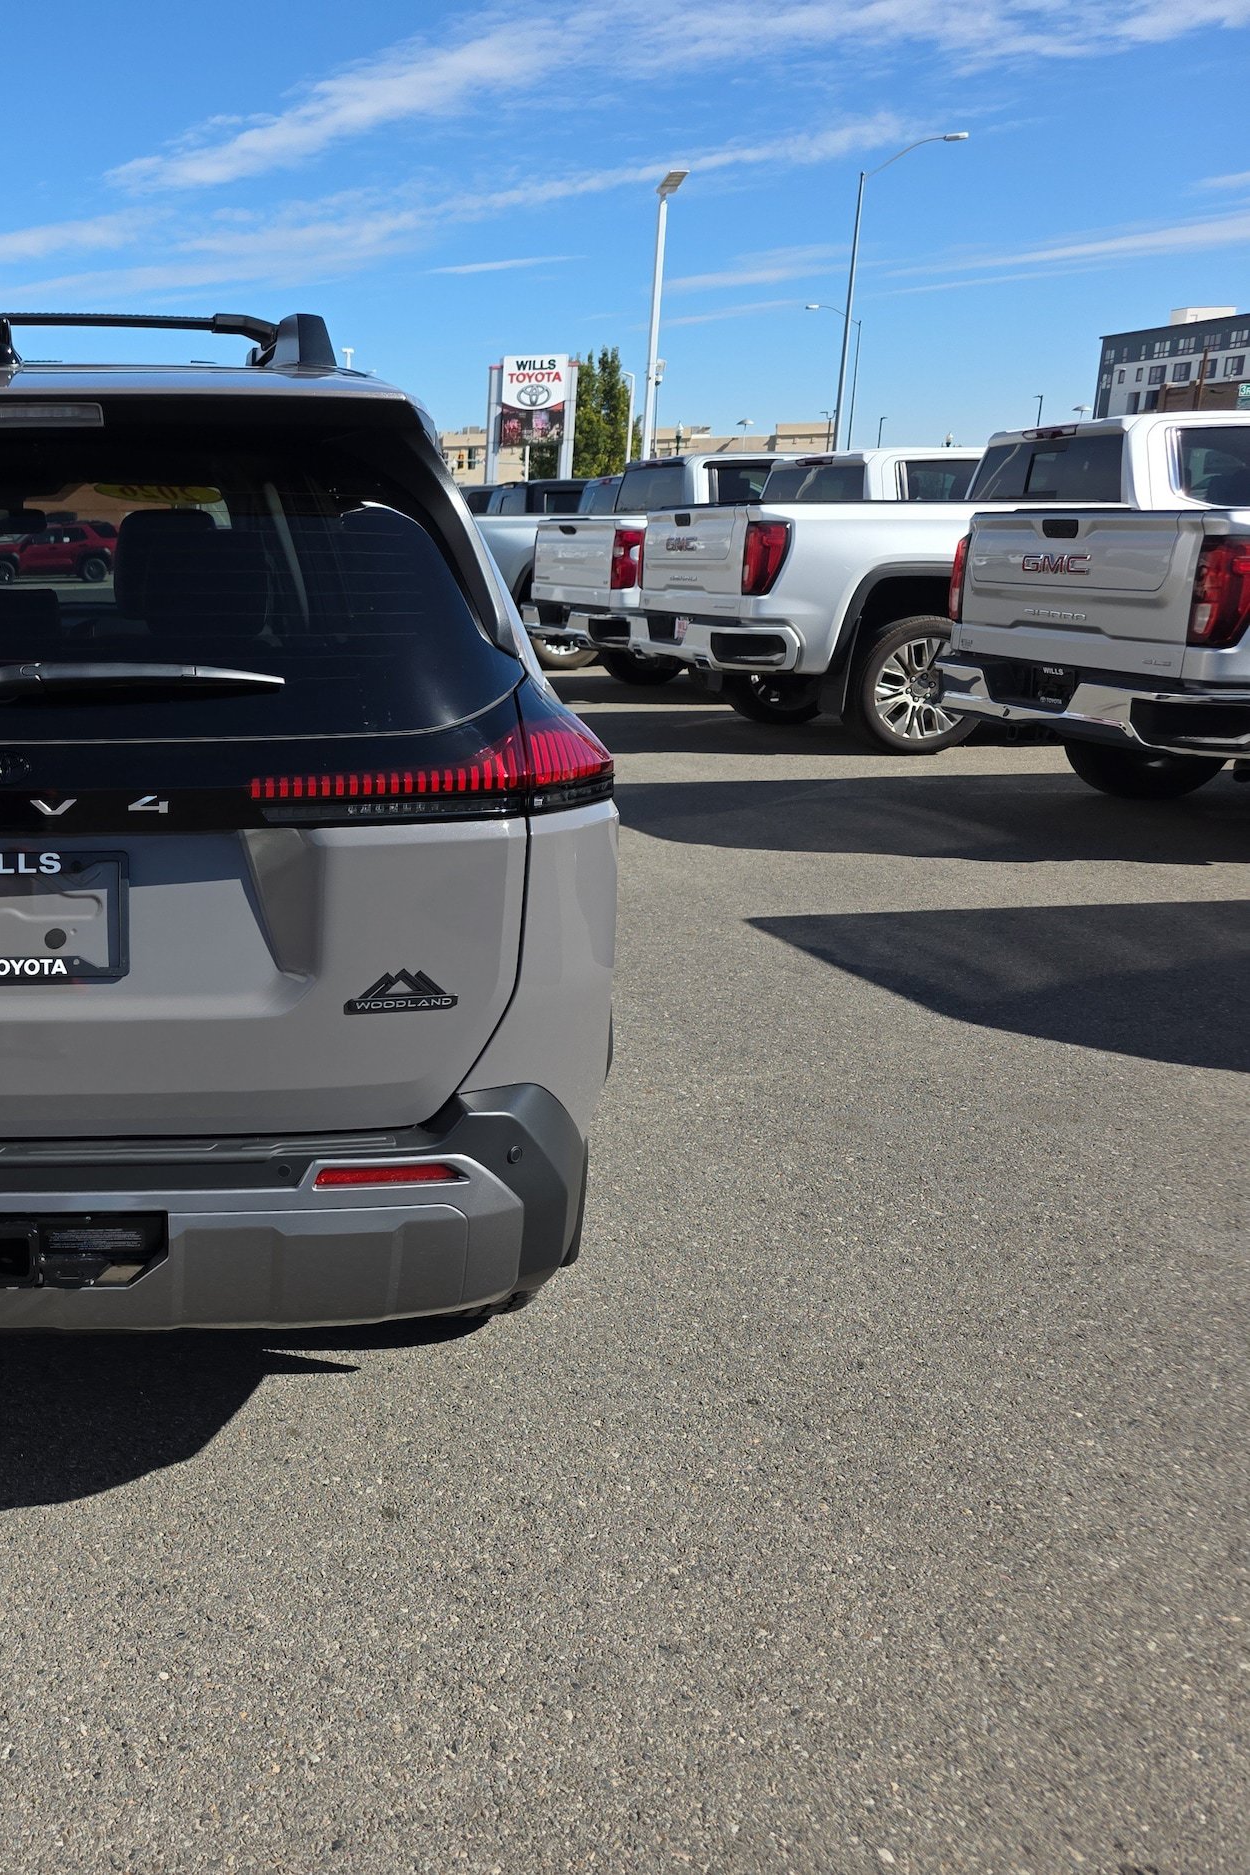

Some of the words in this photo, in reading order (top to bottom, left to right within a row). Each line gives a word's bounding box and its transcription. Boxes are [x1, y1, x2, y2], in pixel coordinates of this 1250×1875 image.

[516, 359, 556, 371] WILLS
[508, 371, 562, 383] TOYOTA
[1021, 554, 1091, 575] GMC
[1023, 608, 1087, 621] SIERRA
[1042, 666, 1064, 676] WILLS
[356, 998, 452, 1010] WOODLAND
